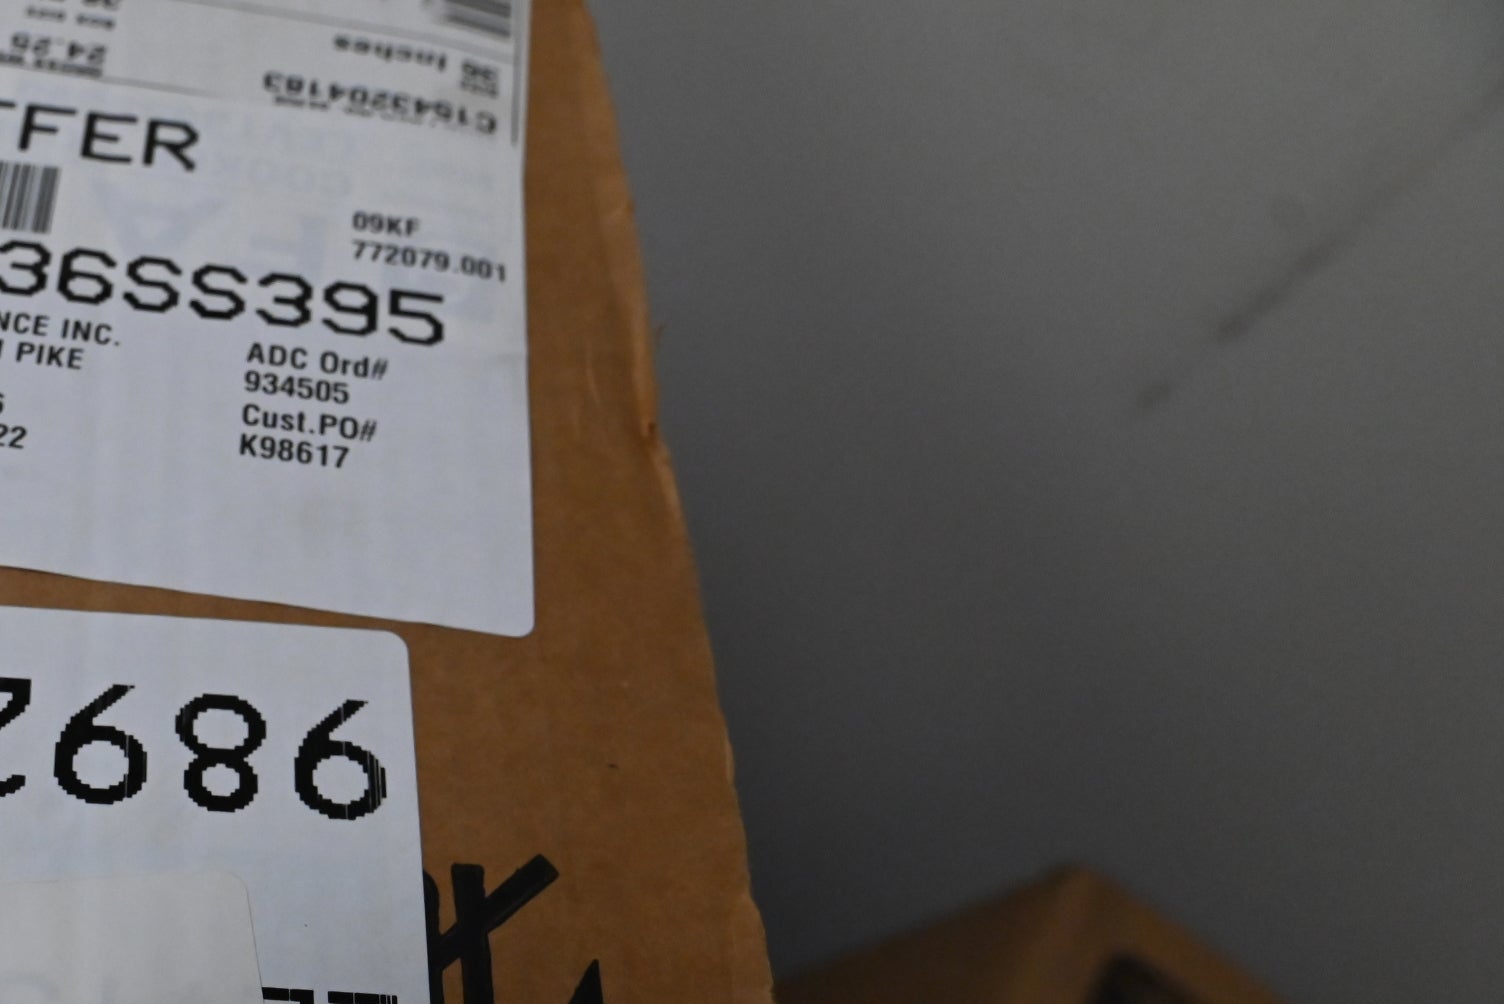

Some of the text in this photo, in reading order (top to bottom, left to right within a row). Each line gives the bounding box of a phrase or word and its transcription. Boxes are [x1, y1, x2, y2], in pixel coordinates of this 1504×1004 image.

[351, 210, 421, 238] 09KF
[351, 239, 506, 282] 772079.001
[61, 317, 121, 347] INC.
[16, 341, 86, 370] PIKE
[246, 342, 388, 380] ADC Ord#
[244, 370, 350, 404] 934505
[241, 403, 377, 442] Cust.PO#
[239, 433, 350, 468] K98617
